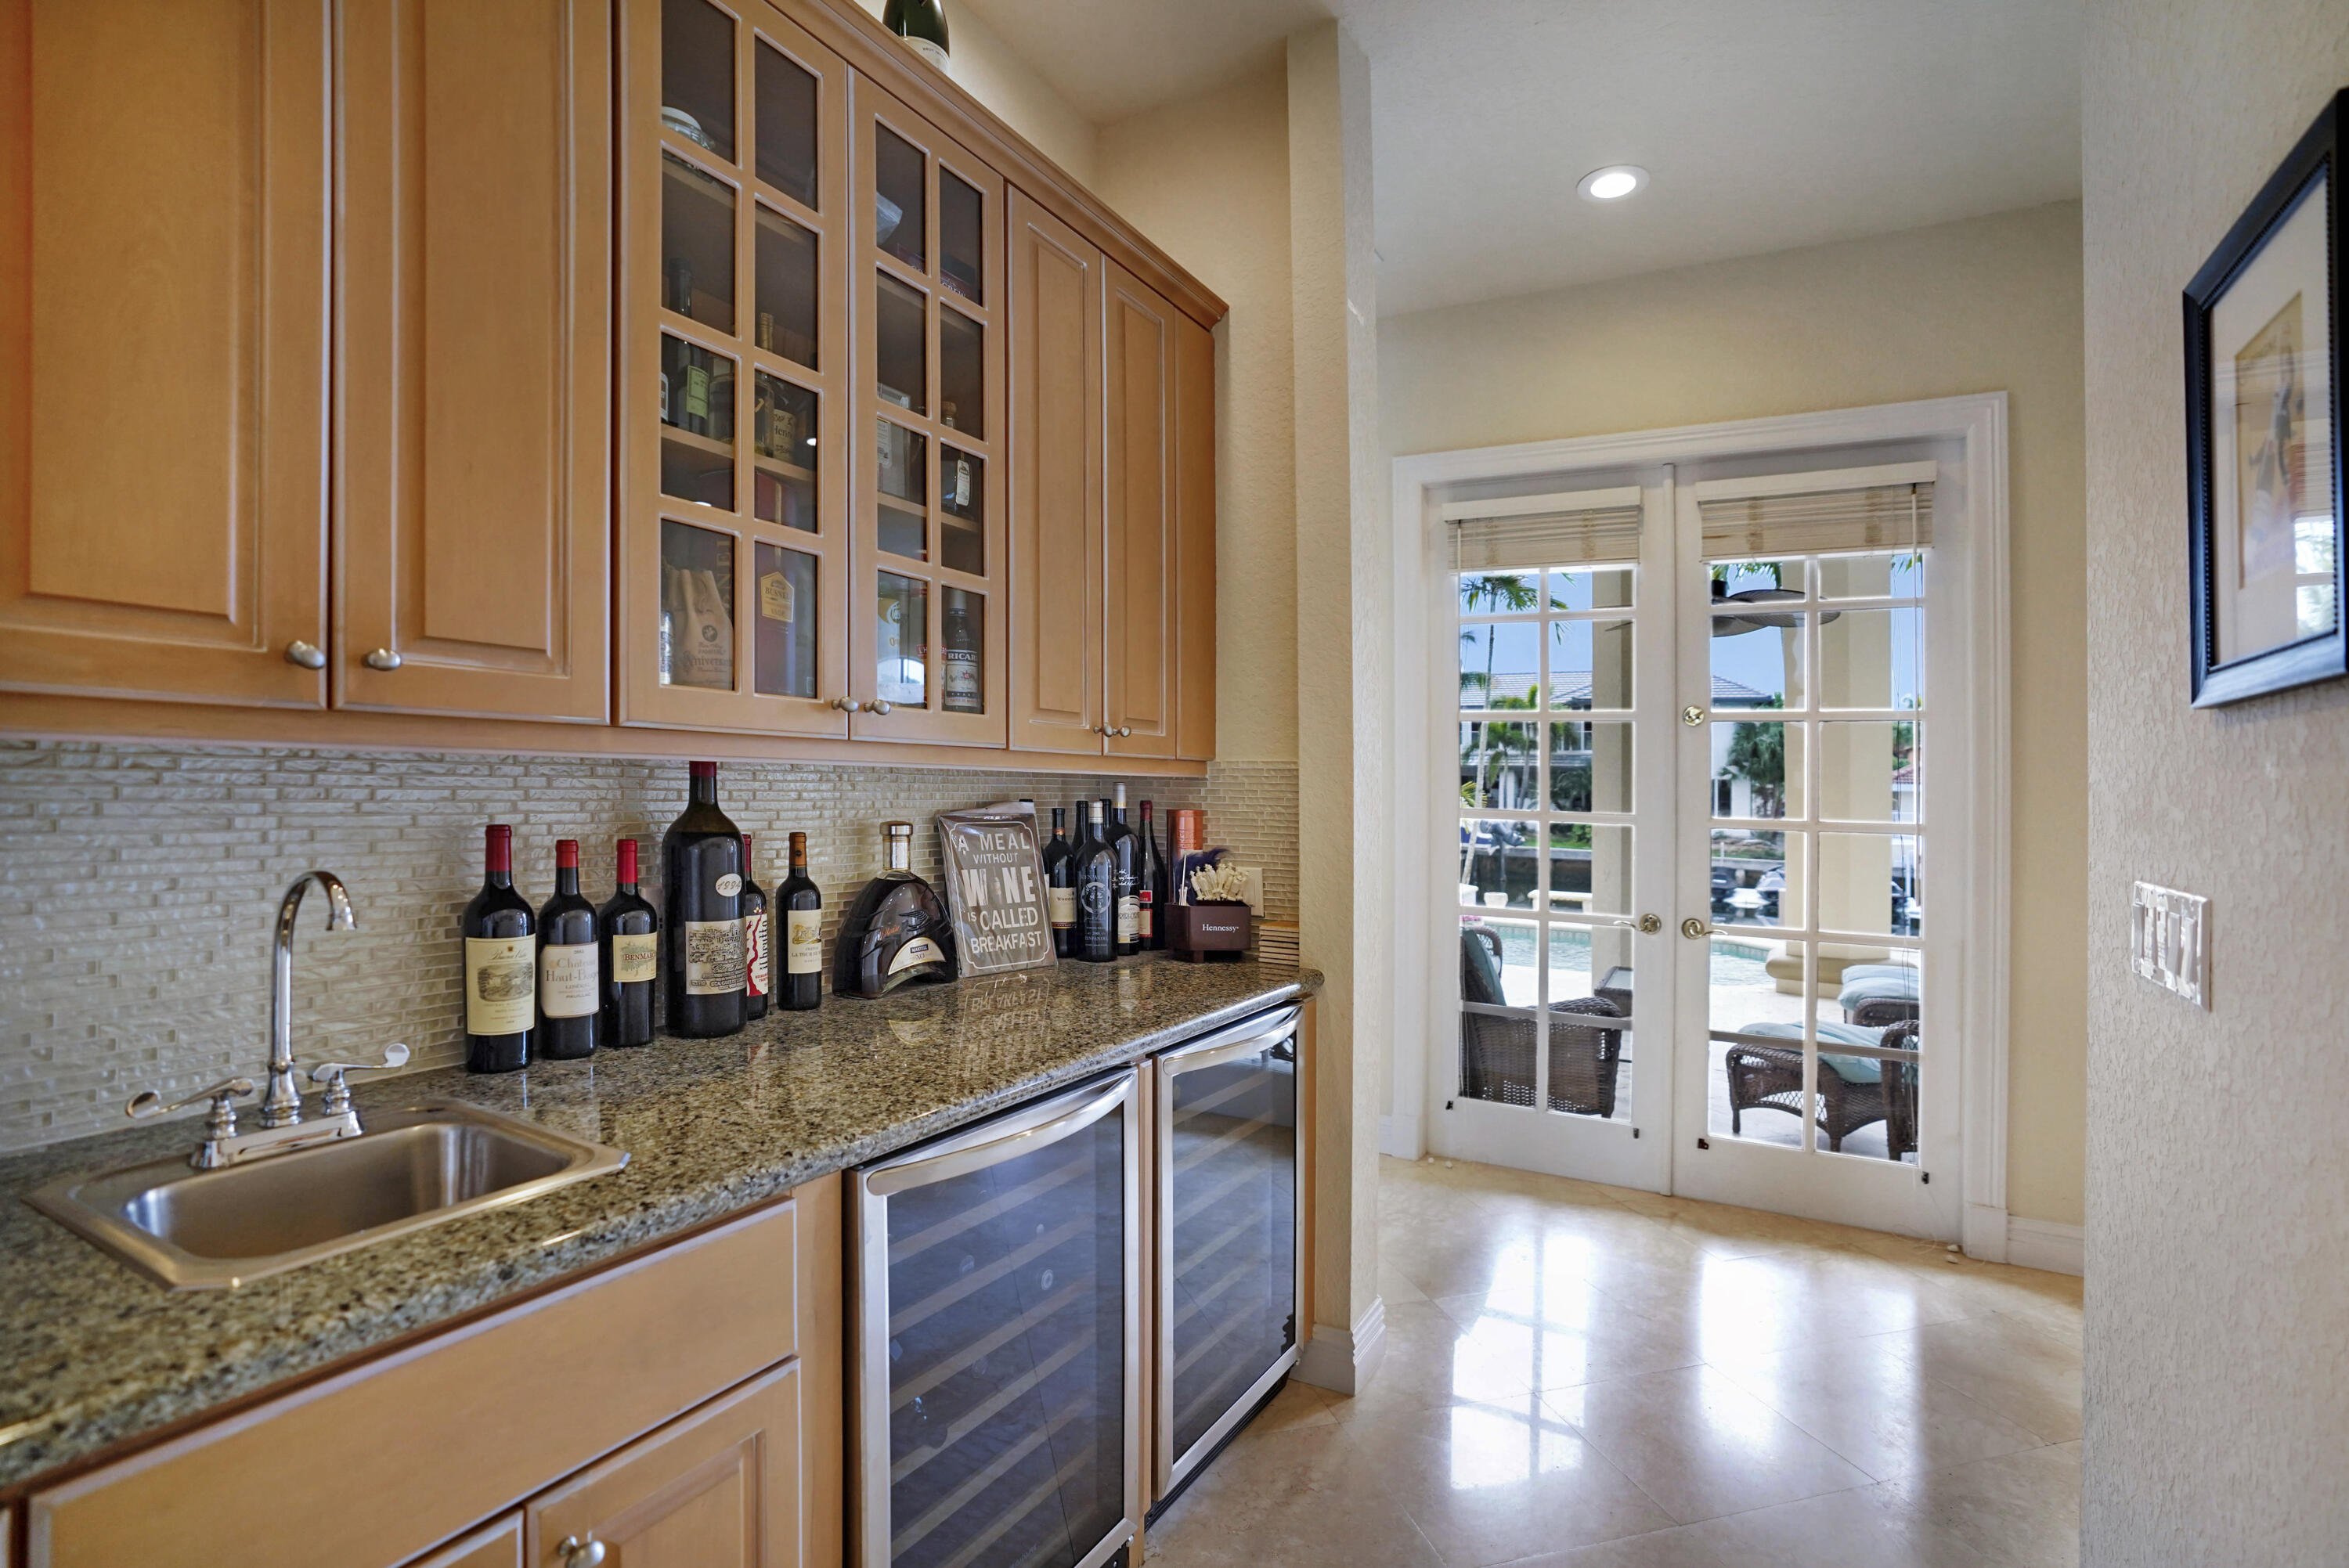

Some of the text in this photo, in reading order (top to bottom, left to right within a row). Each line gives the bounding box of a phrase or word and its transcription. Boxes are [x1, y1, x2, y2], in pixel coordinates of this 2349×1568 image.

[958, 832, 1030, 852] A MEAL
[972, 852, 1018, 864] WITHOUT
[967, 907, 1038, 931] IS CALLED
[1202, 924, 1237, 933] Hennessy
[970, 930, 1042, 954] BREAKFAST
